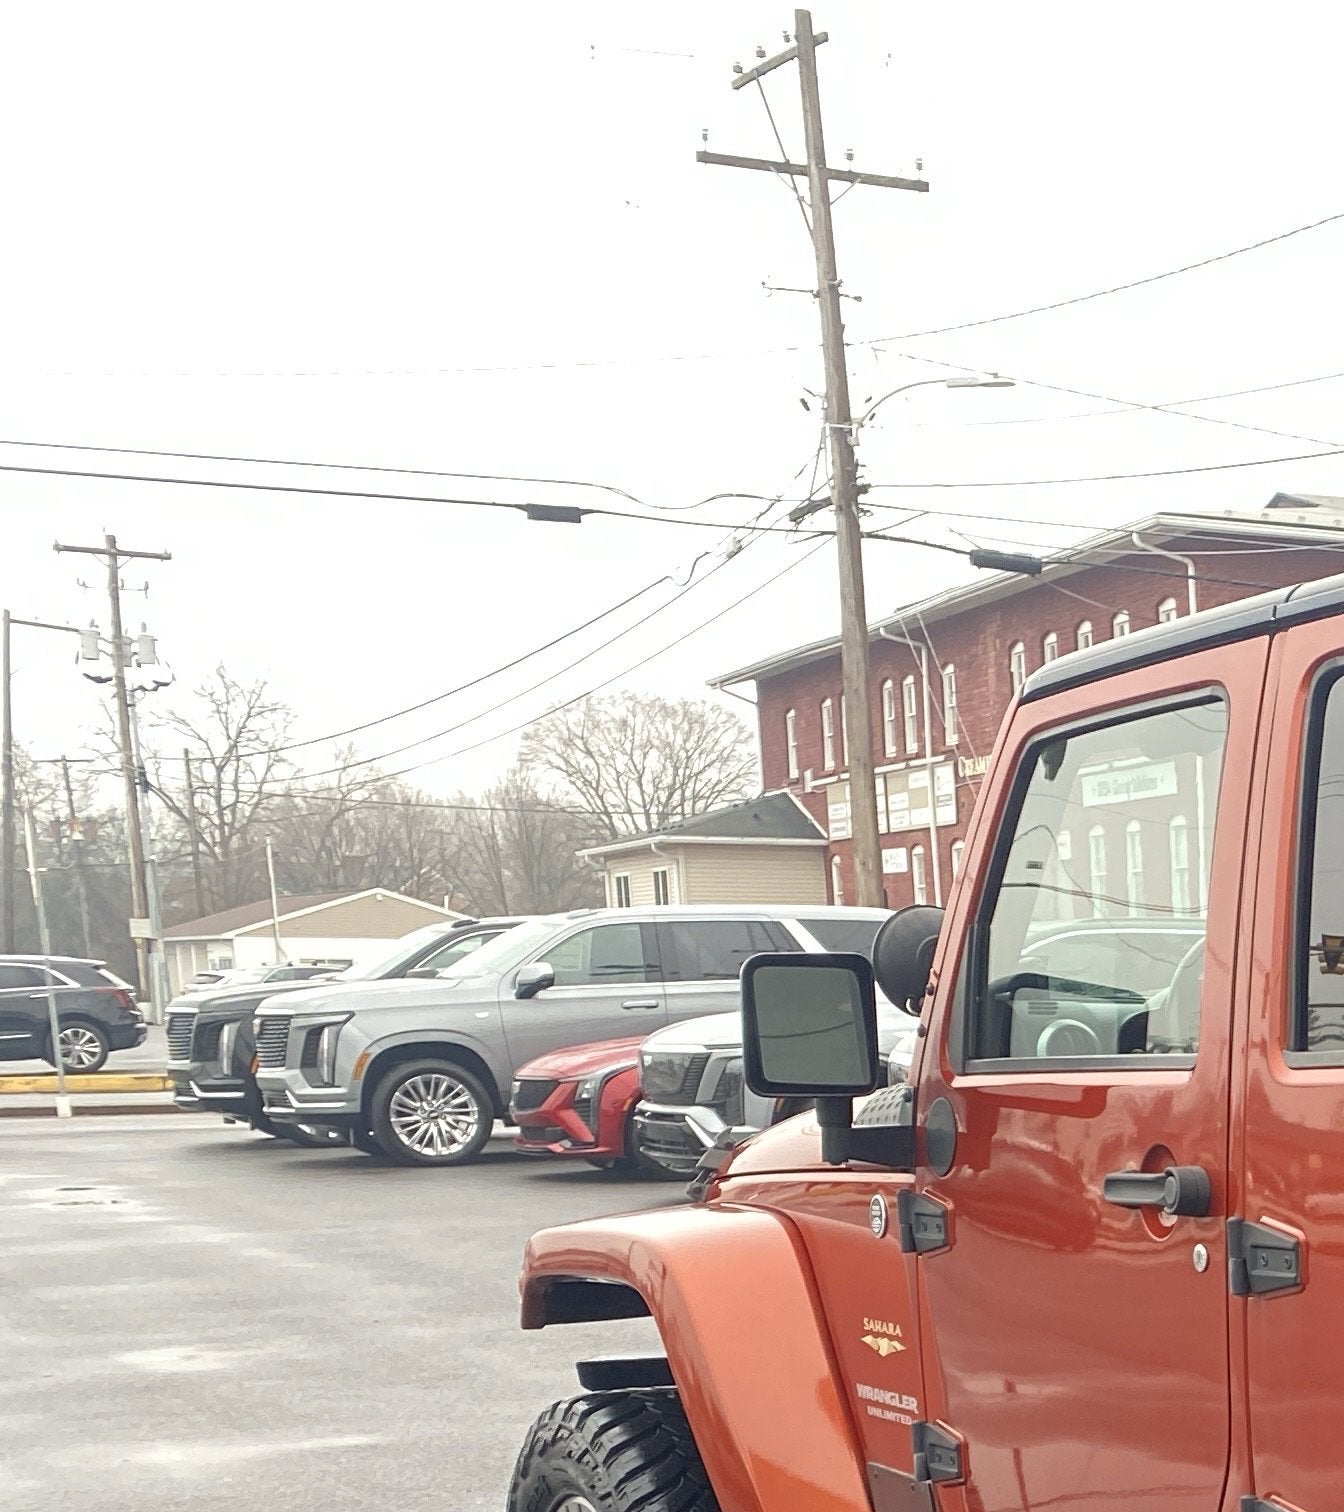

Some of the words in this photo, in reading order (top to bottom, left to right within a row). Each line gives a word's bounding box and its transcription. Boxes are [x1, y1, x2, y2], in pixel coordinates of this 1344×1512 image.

[863, 1317, 902, 1337] SAHARA
[856, 1383, 918, 1414] WRANGLER
[867, 1405, 912, 1425] UNLIMITED
